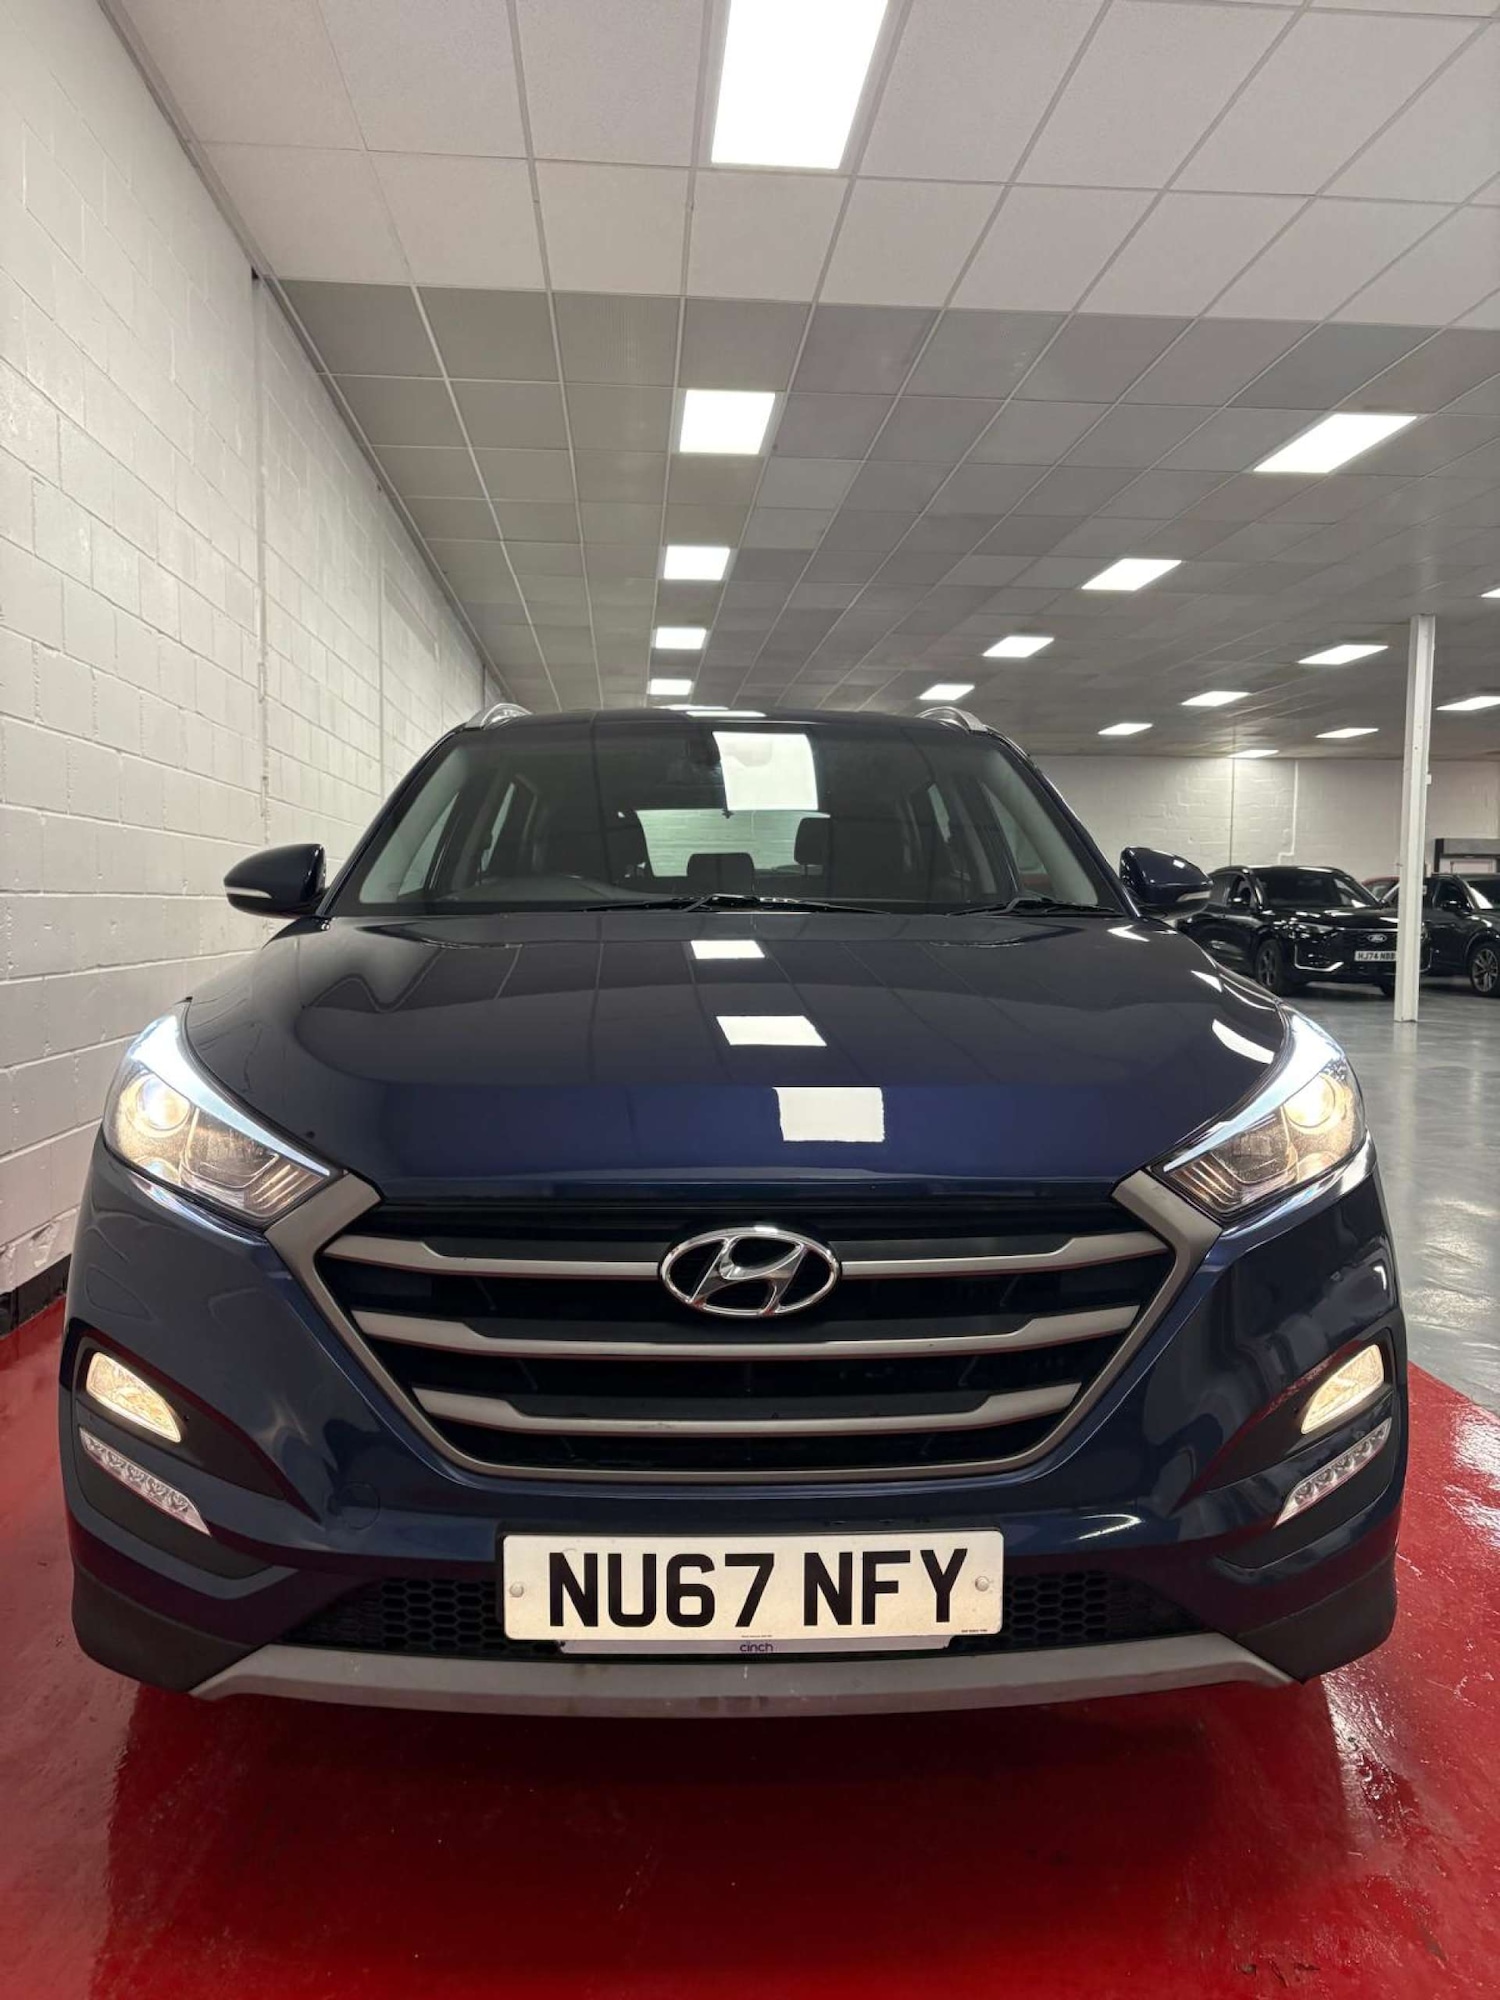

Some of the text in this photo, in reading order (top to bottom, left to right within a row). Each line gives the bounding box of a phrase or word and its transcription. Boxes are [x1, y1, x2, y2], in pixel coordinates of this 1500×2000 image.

[549, 1548, 968, 1628] NU67 NFY
[739, 1642, 774, 1652] cinch
